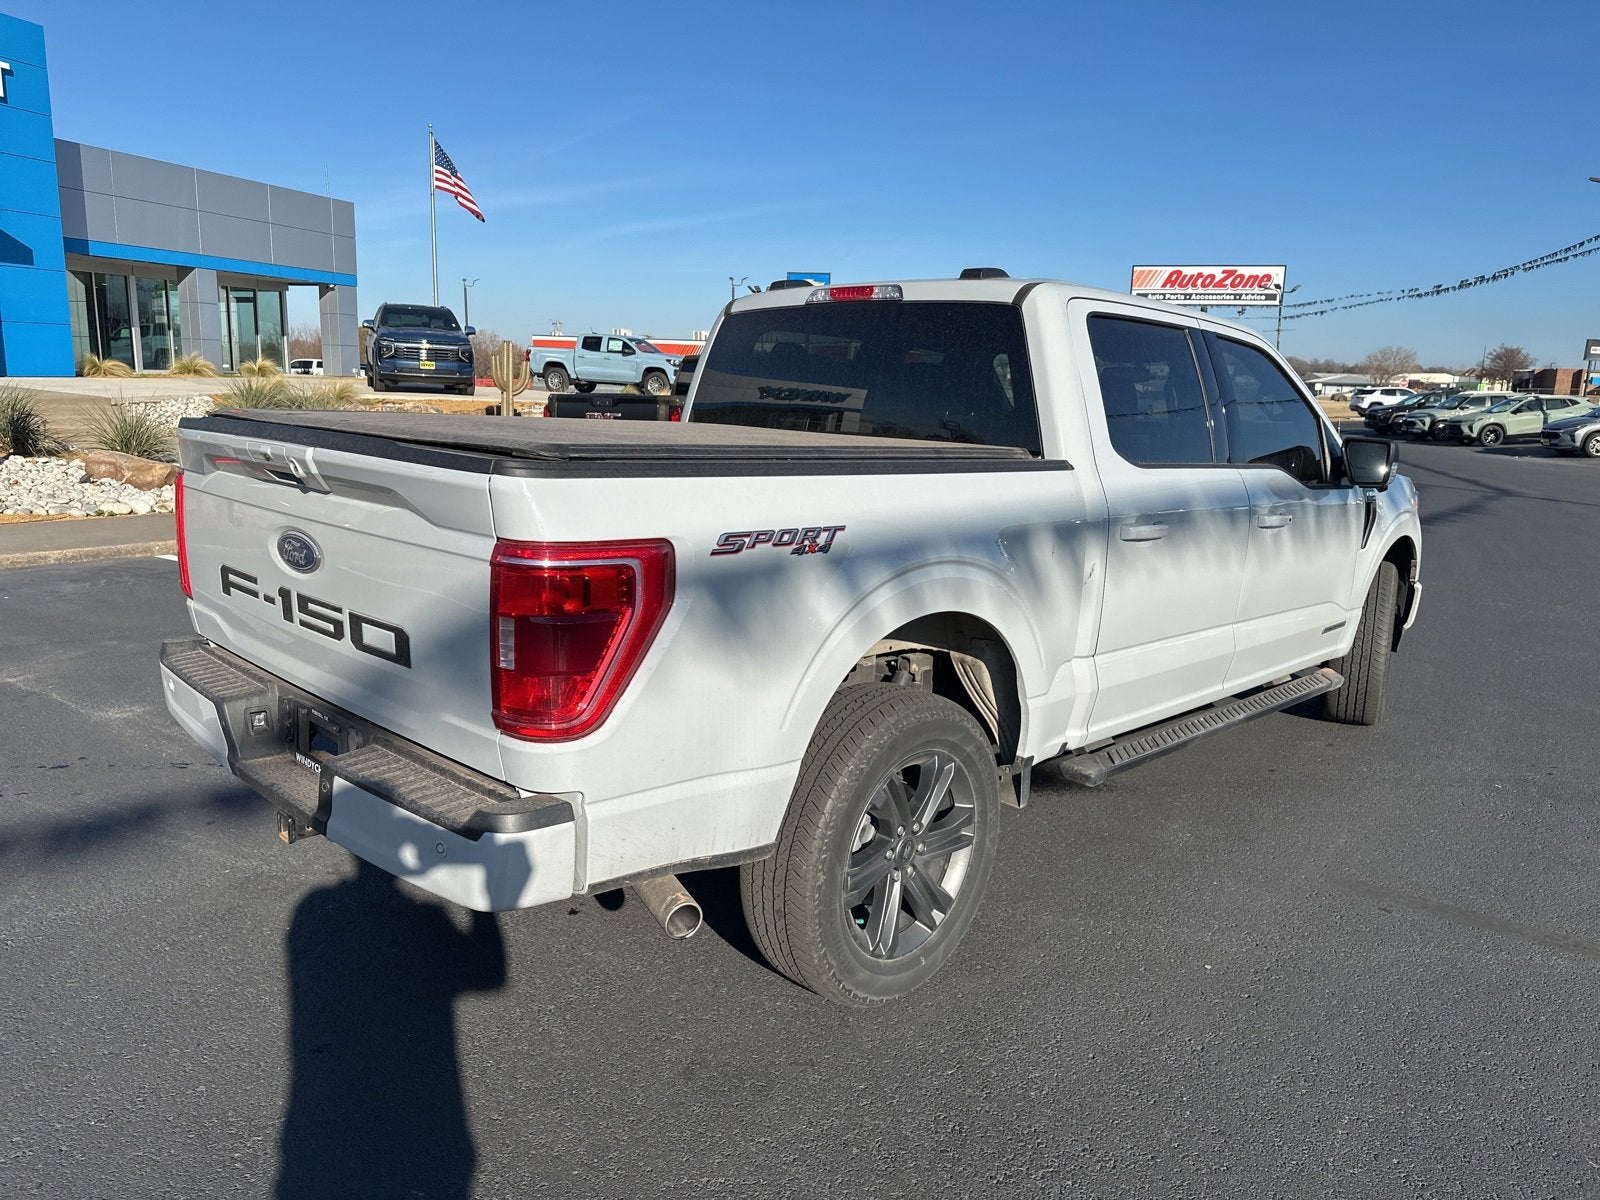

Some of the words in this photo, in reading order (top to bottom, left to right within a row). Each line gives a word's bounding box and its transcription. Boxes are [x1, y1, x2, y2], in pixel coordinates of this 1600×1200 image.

[1161, 269, 1273, 289] AutoZone
[283, 538, 307, 566] Ford
[710, 525, 846, 556] SPORT
[220, 564, 412, 669] F-150
